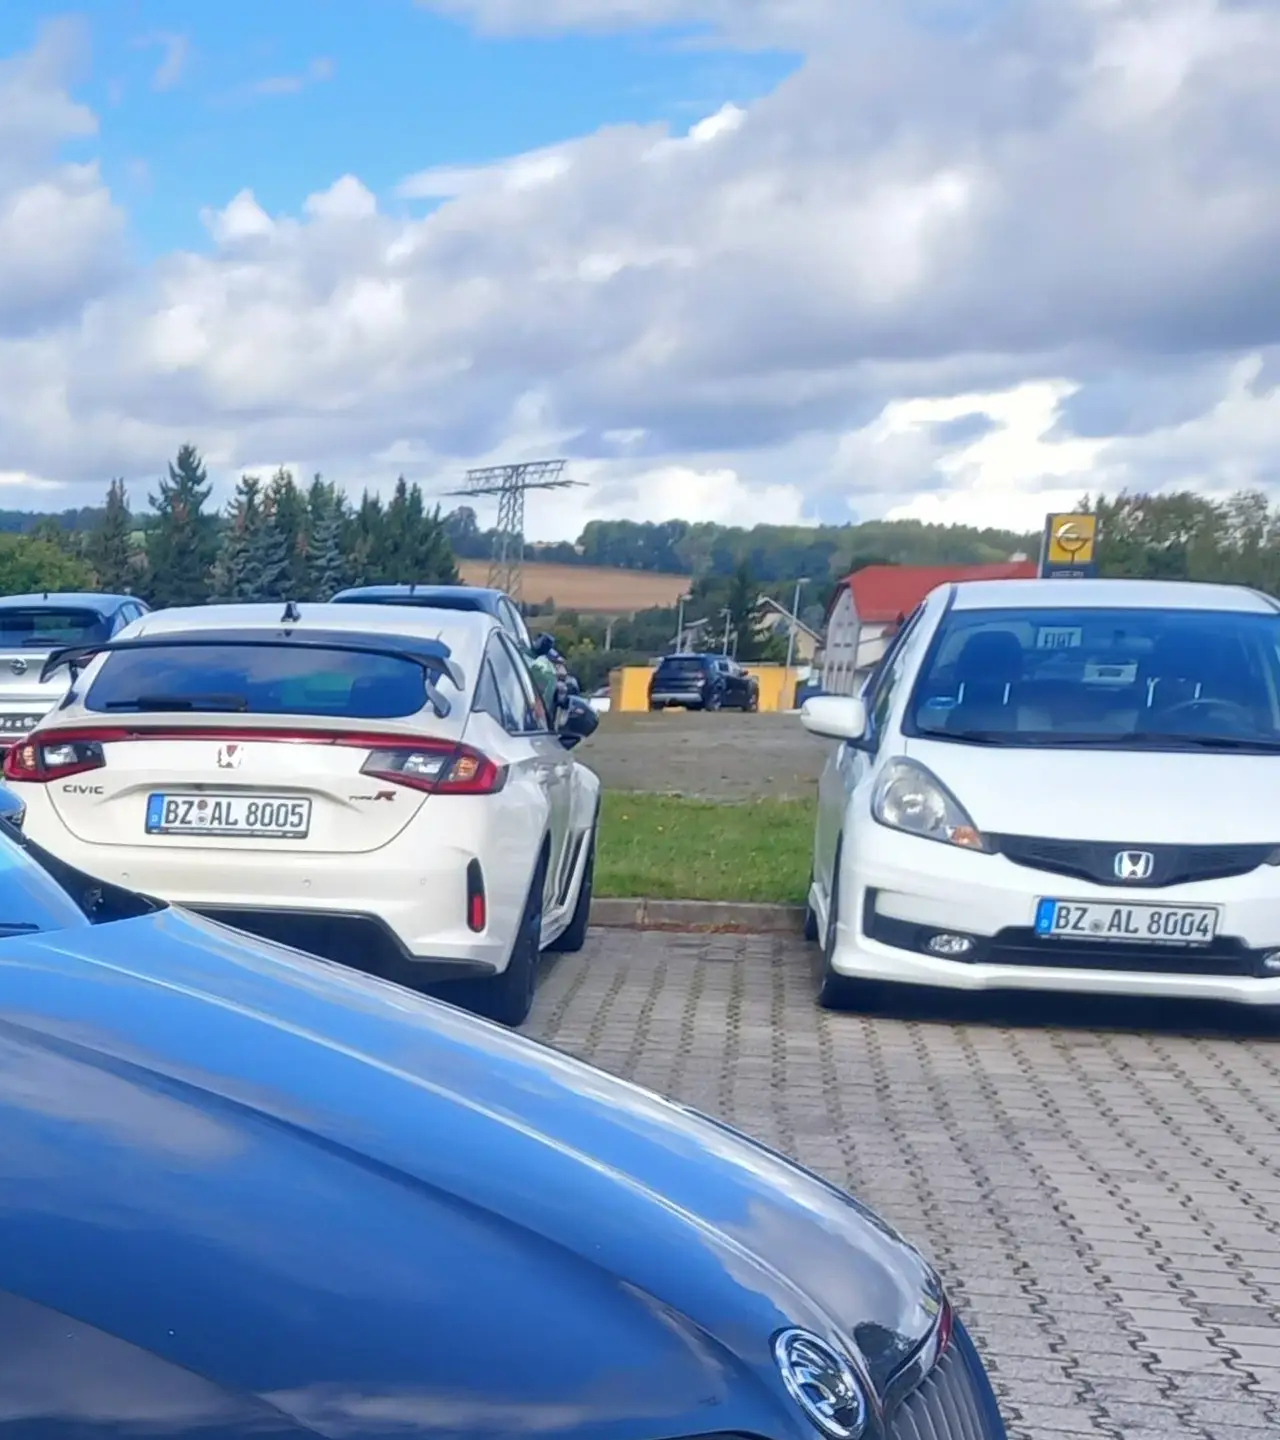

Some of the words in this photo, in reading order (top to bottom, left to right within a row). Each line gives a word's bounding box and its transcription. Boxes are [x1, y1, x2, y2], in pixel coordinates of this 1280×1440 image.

[63, 784, 104, 795] CIVIC
[164, 800, 195, 825] BZ
[209, 801, 239, 826] AL
[245, 802, 305, 828] 8005
[1055, 906, 1089, 931] BZ
[1107, 908, 1140, 935] AL
[1147, 911, 1210, 938] 8004
